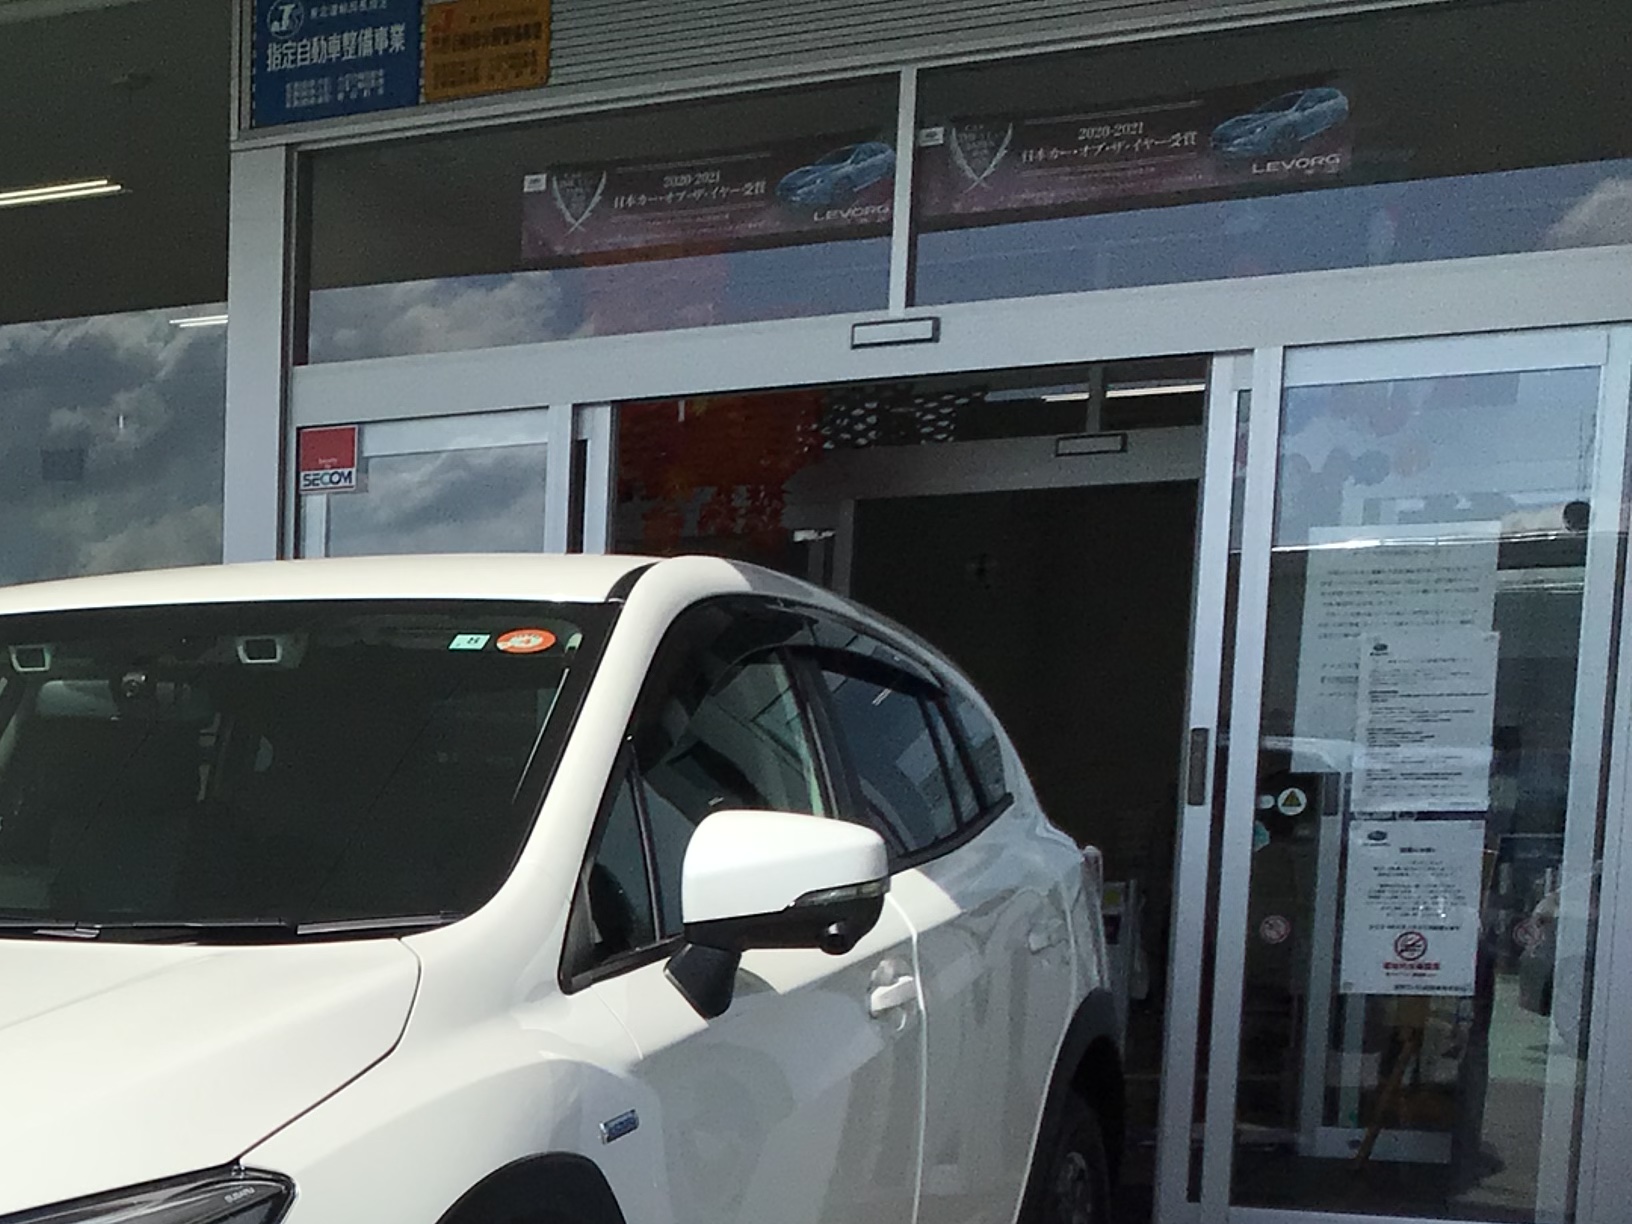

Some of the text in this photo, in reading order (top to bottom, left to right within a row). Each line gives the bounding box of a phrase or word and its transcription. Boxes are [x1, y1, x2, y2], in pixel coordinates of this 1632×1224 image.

[266, 23, 406, 72] 指定自動車整備事業
[1078, 121, 1144, 141] 2020-2021
[1251, 153, 1343, 175] LEVORG
[303, 470, 352, 487] SECOM
